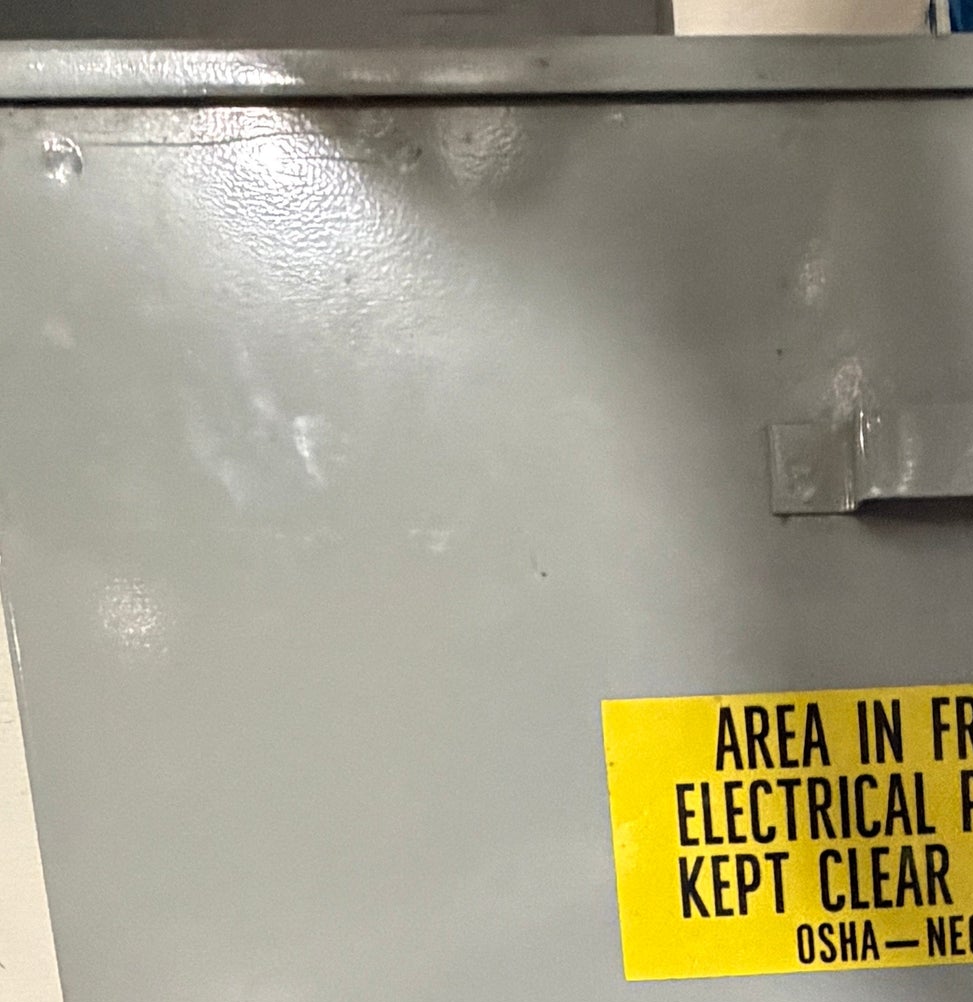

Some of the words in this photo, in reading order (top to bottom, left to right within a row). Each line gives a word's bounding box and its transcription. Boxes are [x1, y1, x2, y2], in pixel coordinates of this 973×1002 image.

[715, 702, 831, 771] AREA
[858, 699, 904, 765] IN
[676, 772, 936, 847] ELECTRICAL
[678, 852, 790, 919] KEPT
[819, 844, 954, 912] CLEAR
